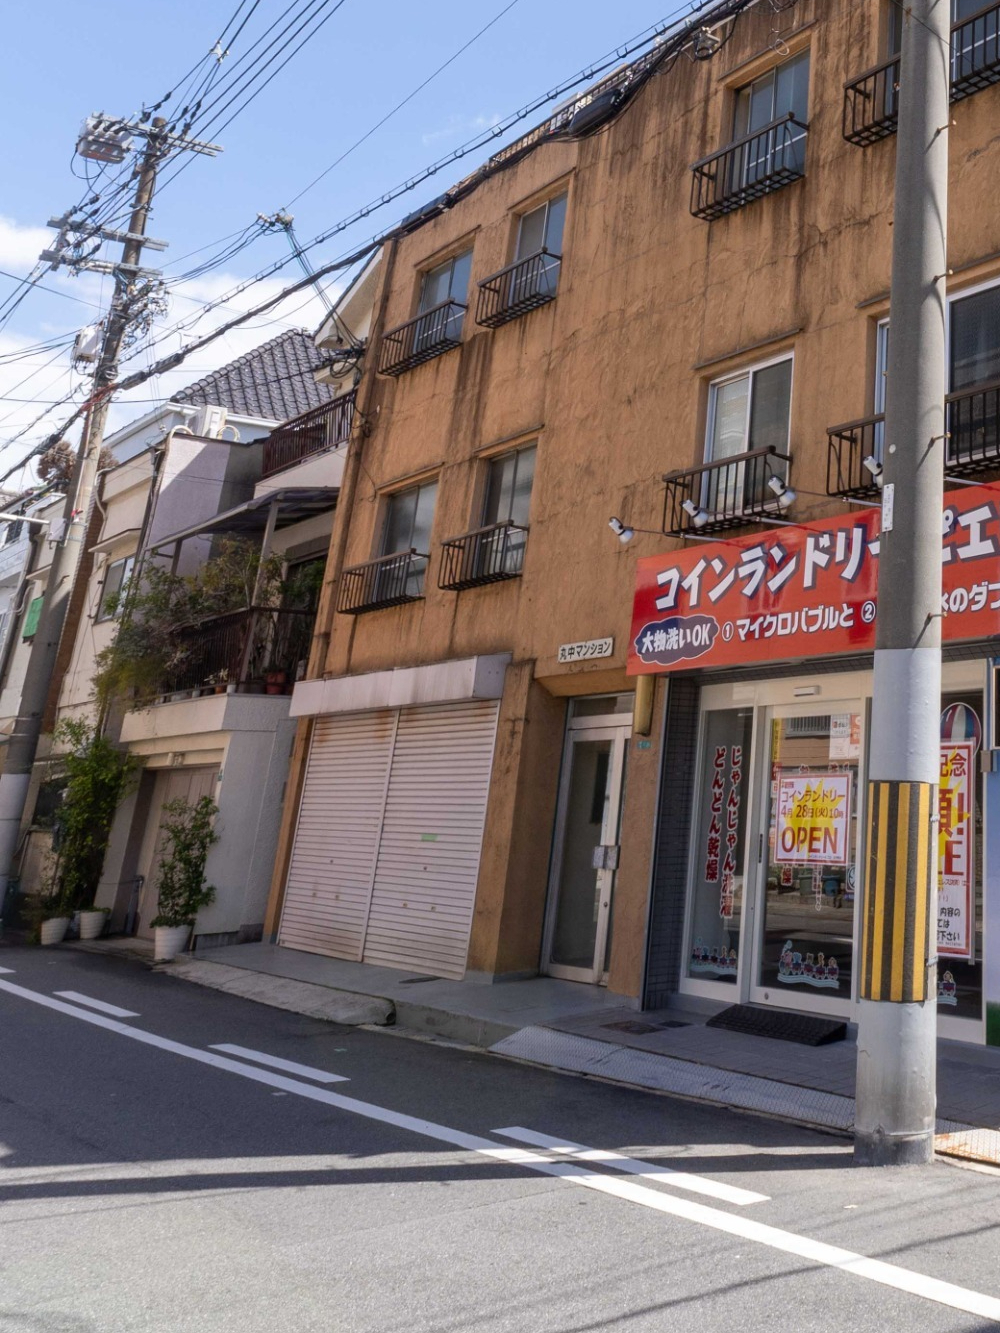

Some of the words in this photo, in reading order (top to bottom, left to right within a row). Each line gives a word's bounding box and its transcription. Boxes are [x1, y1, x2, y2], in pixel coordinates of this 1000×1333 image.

[781, 789, 846, 803] コインランドリー
[781, 826, 838, 854] OPEN
